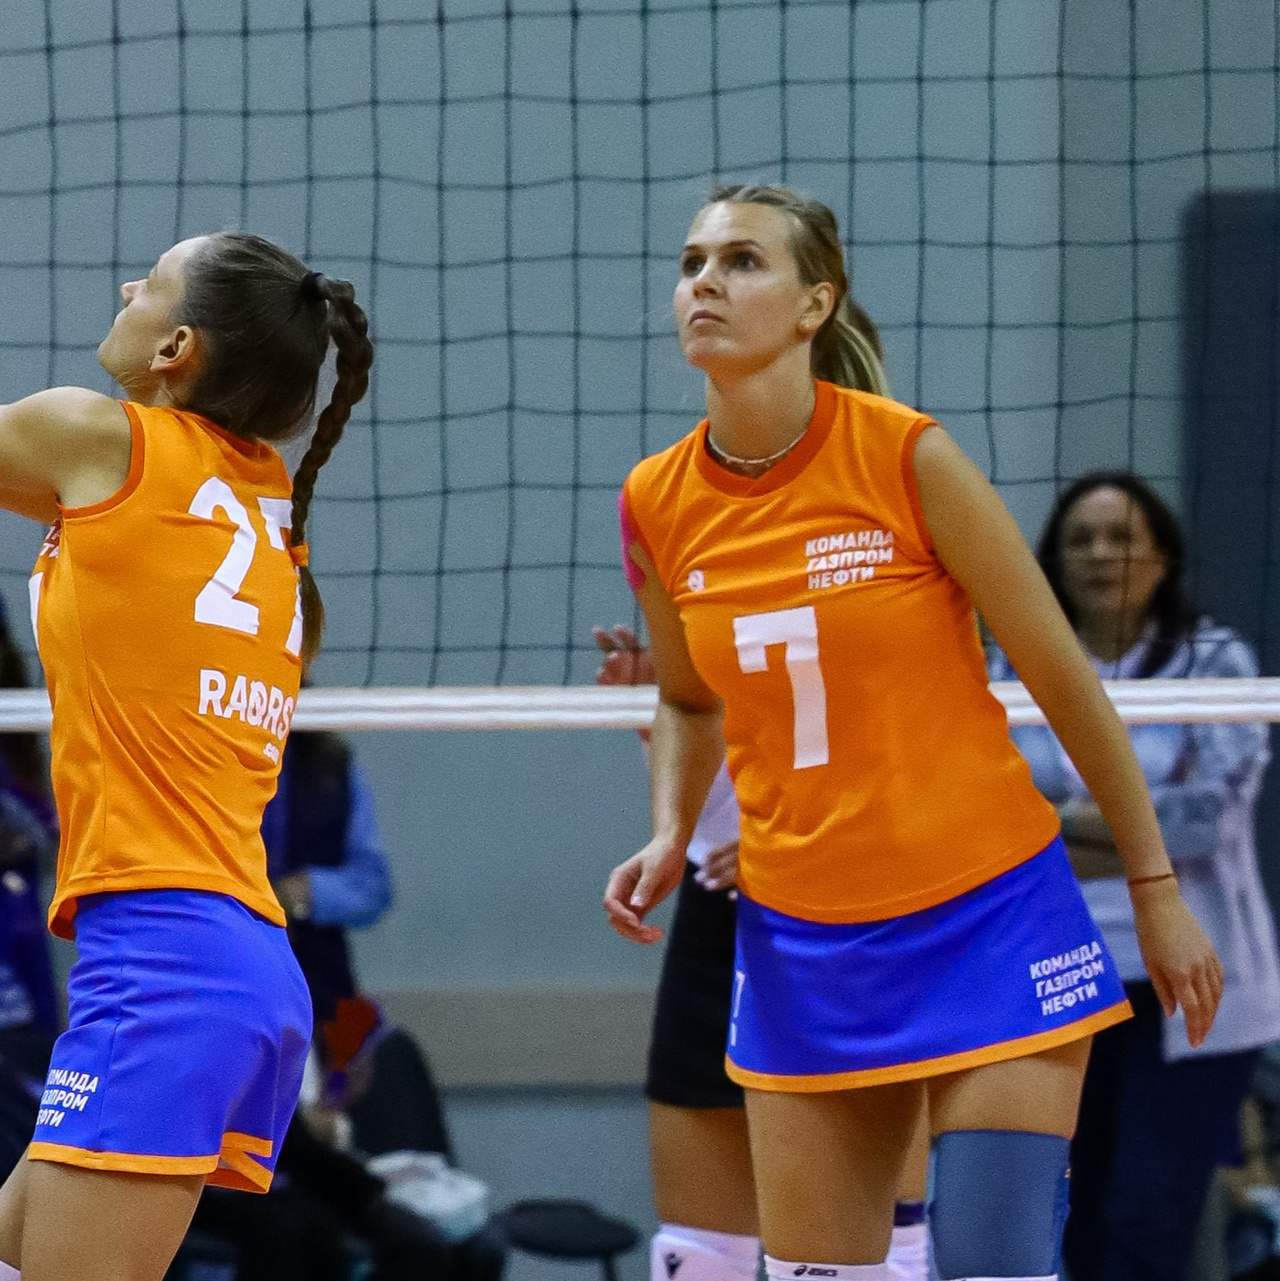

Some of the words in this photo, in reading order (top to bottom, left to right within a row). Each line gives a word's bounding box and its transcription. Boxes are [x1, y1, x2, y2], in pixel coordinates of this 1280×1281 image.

[805, 529, 894, 557] КОМАНДА
[806, 547, 894, 572] ГАЗПРОМ
[807, 566, 875, 590] НЕФТИ
[733, 605, 829, 770] 7
[1030, 941, 1102, 980] КОМАНДА
[1036, 960, 1104, 998] ГАЗПРОМ
[1041, 981, 1098, 1016] НЕФТИ
[47, 1069, 99, 1093] МАНДА
